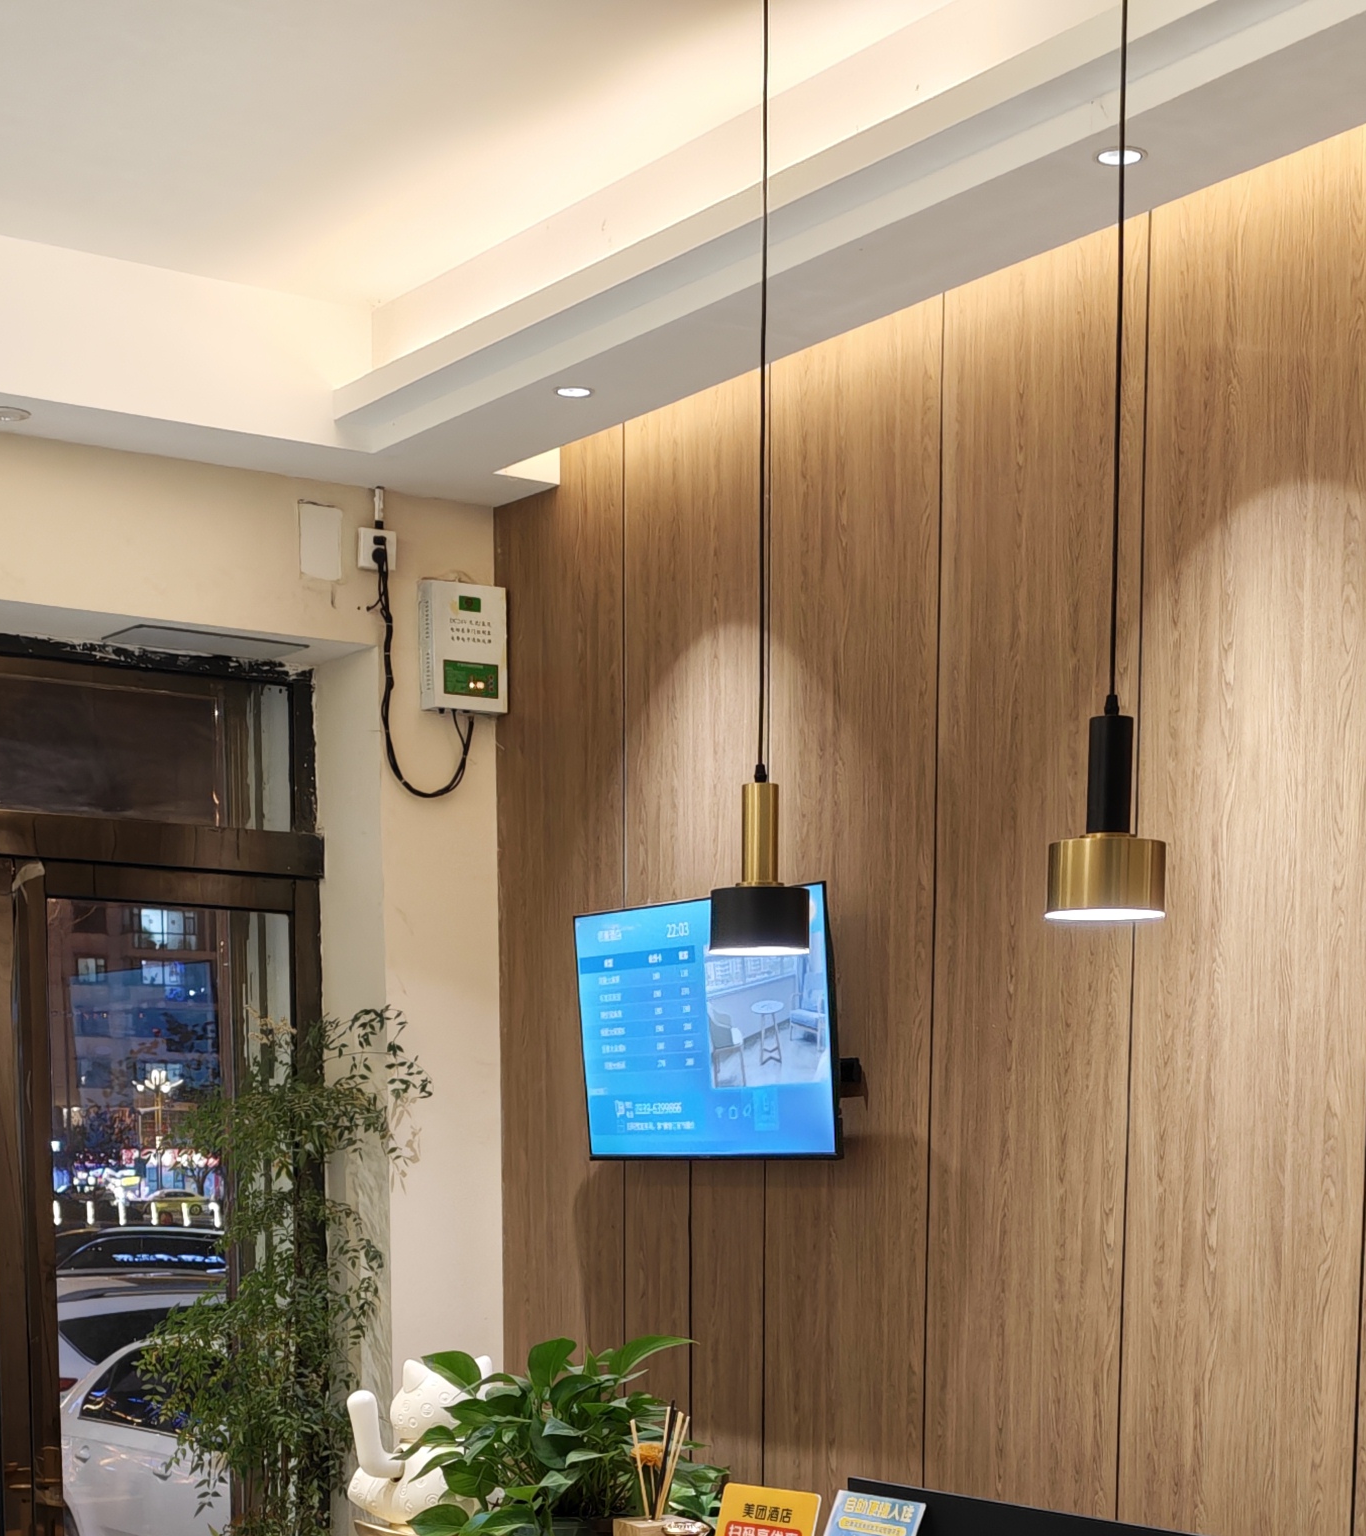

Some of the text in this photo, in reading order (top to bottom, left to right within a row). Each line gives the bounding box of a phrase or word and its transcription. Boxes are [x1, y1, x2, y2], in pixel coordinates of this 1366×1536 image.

[666, 922, 690, 938] 22:03
[742, 1502, 793, 1524] 美团酒店
